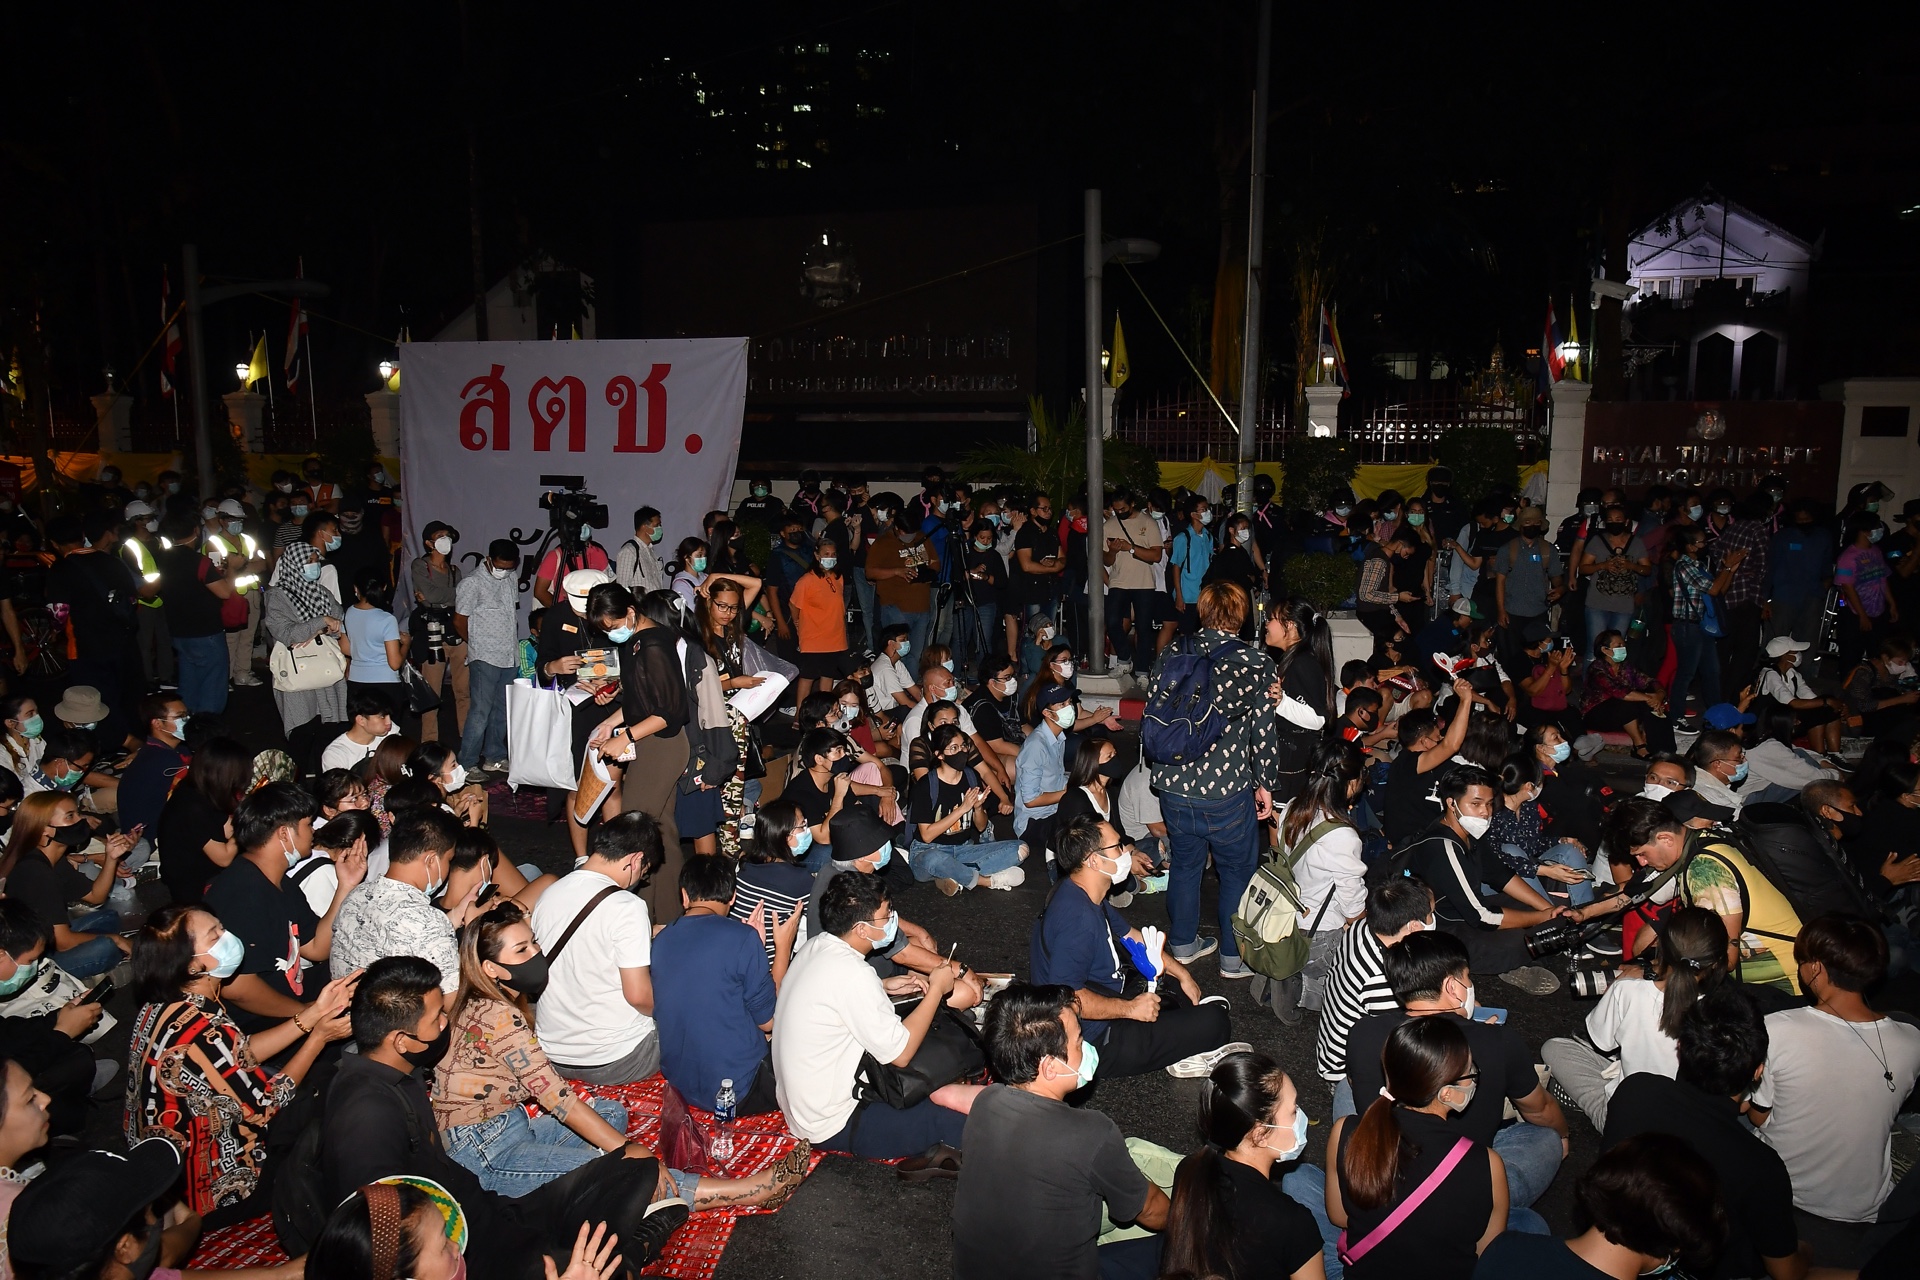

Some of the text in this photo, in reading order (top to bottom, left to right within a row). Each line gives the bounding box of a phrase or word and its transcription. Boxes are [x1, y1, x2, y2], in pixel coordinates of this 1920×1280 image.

[459, 363, 703, 454] สตช.
[1592, 445, 1821, 465] ROYAL THAI POLICE
